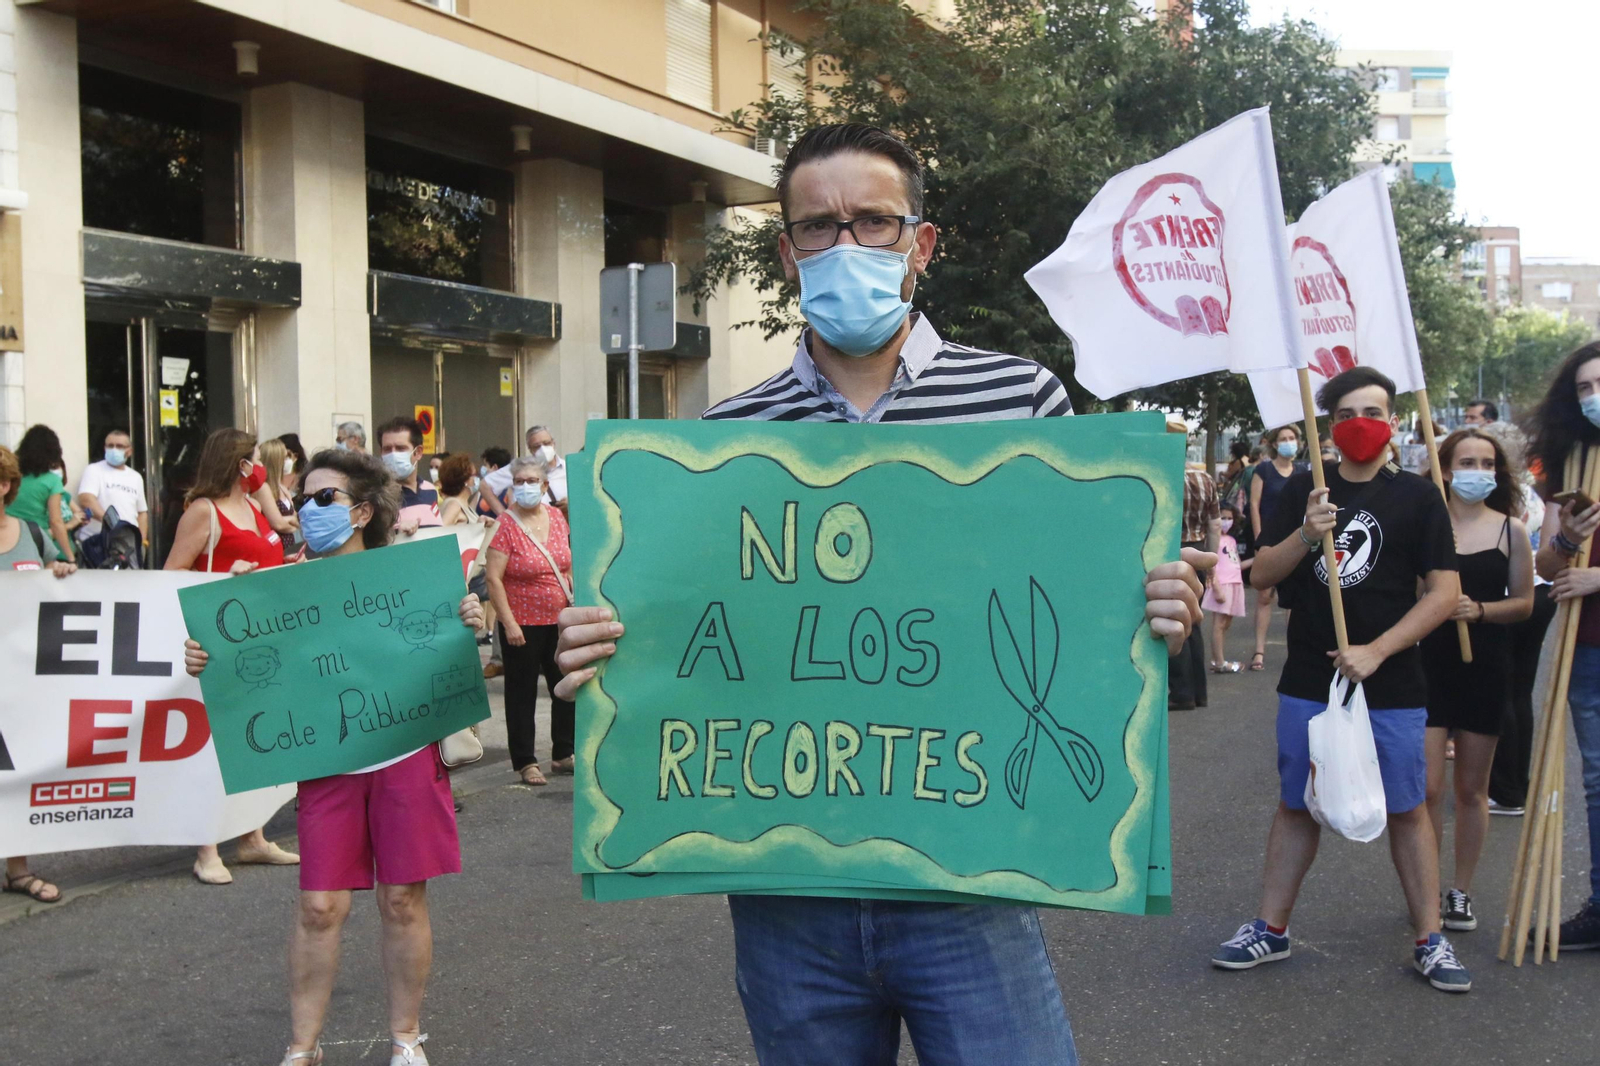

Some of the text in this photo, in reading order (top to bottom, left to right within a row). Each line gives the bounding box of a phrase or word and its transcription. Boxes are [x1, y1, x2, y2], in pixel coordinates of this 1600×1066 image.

[418, 182, 441, 203] DE
[422, 212, 433, 231] 4
[740, 501, 873, 584] NO
[35, 601, 173, 677] EL
[216, 581, 410, 643] Quiero elegir
[312, 647, 350, 677] mi
[676, 602, 940, 687] A LOS
[245, 688, 430, 753] Cole Público
[35, 782, 104, 801] CCOO
[657, 718, 989, 808] RECORTES
[29, 805, 134, 825] enseñanza
